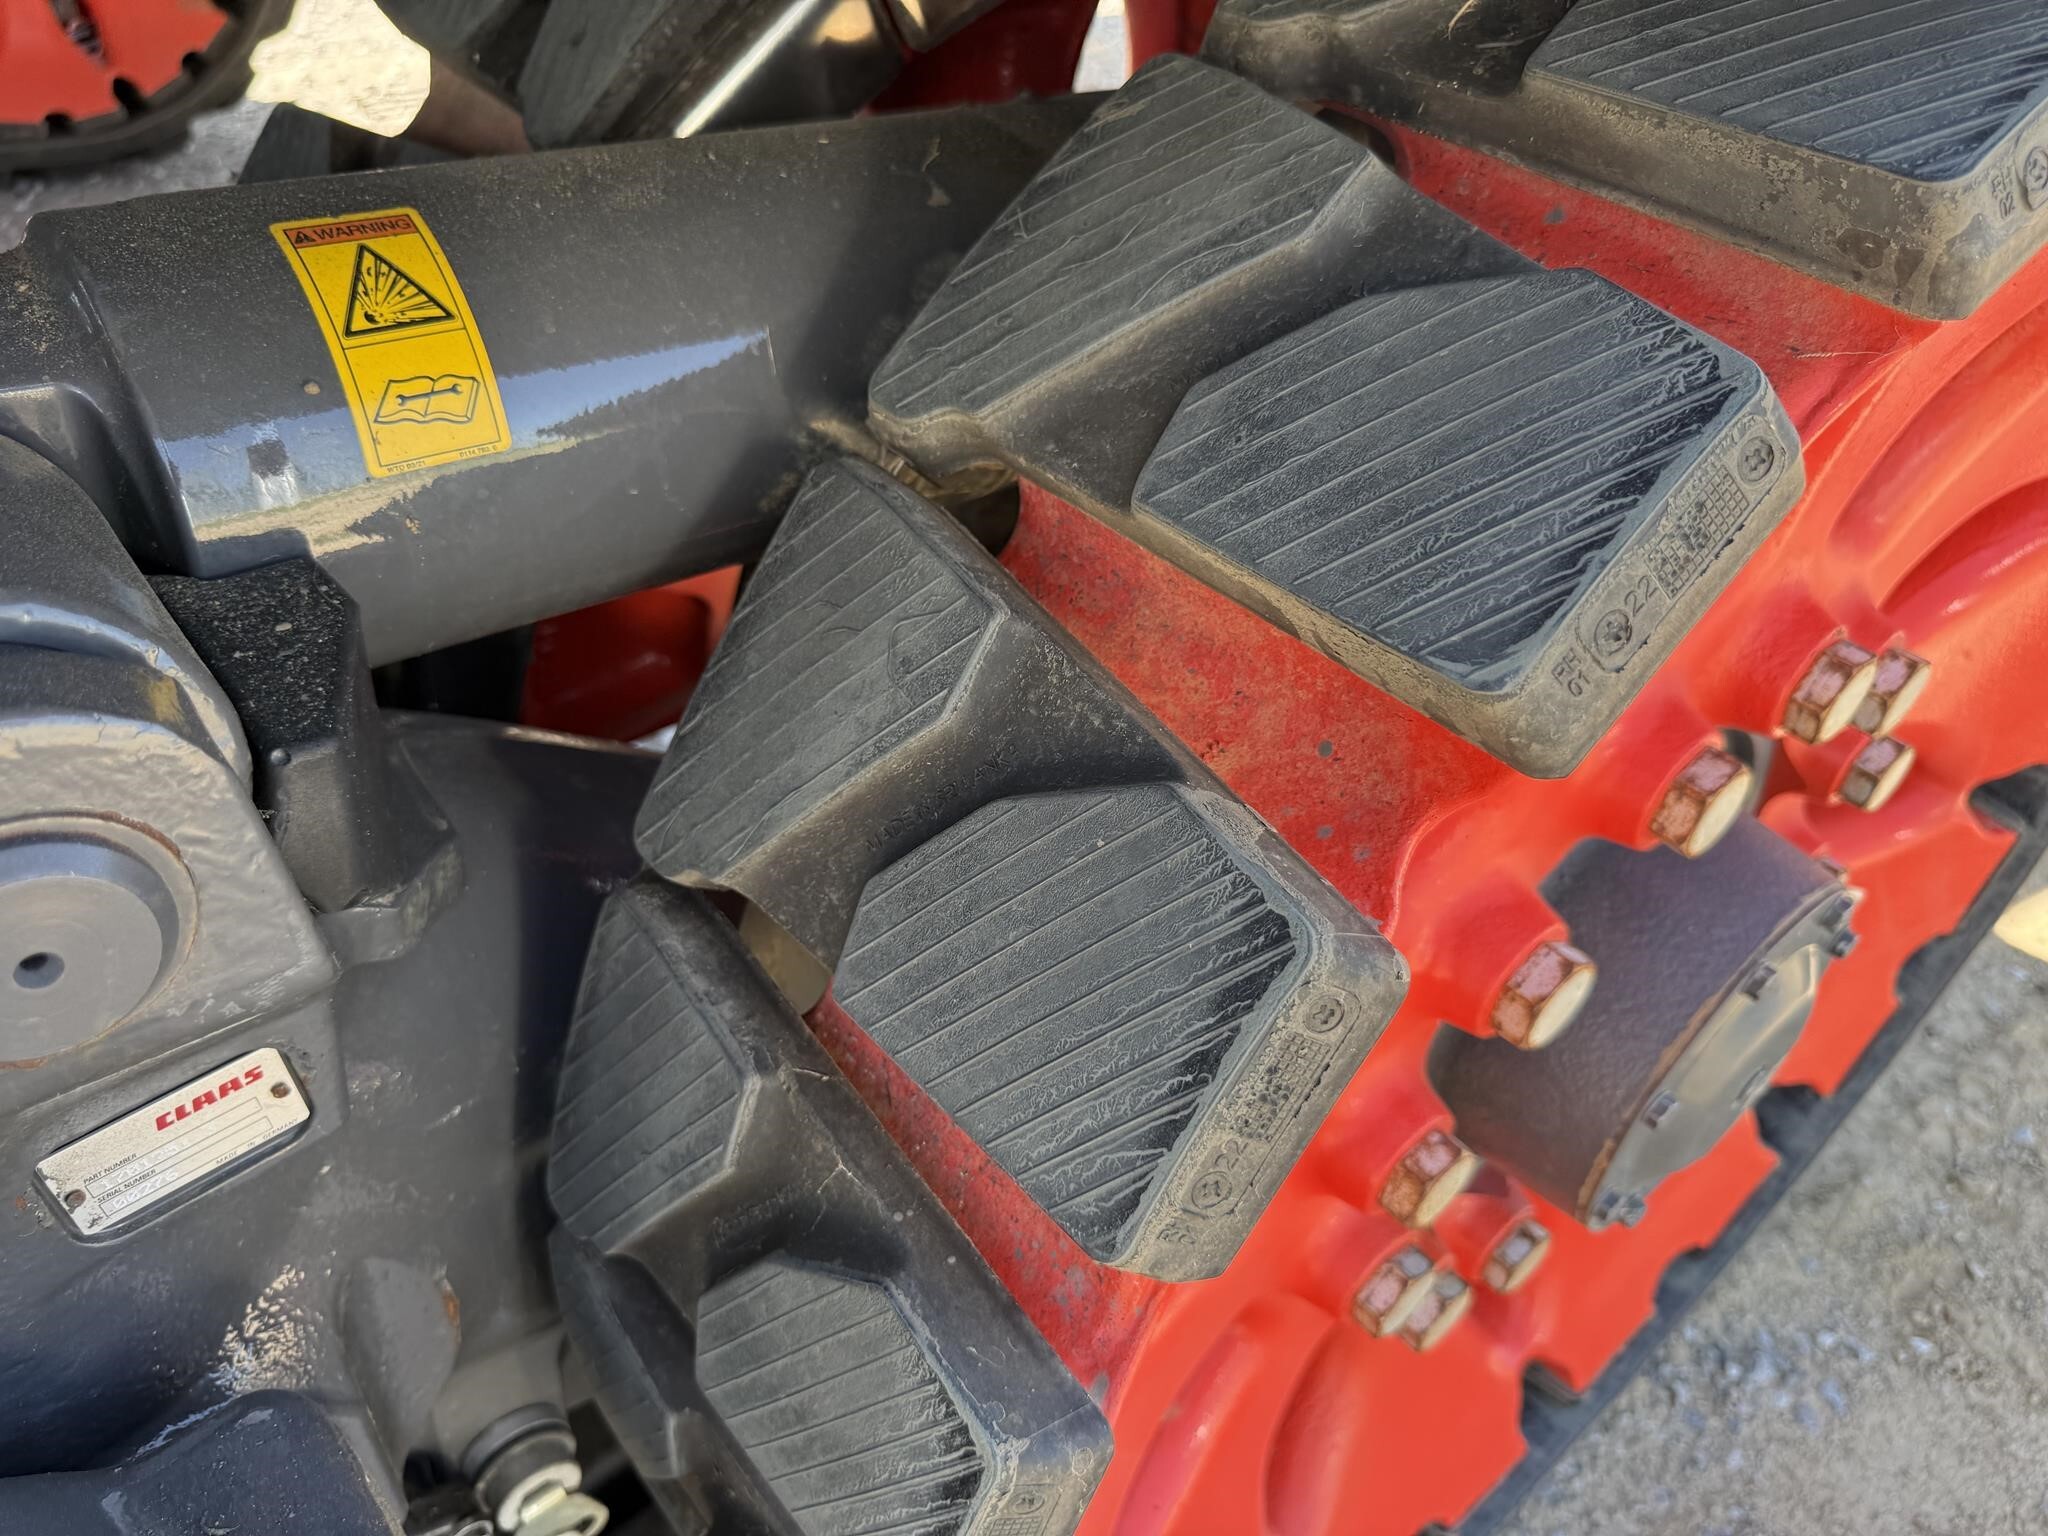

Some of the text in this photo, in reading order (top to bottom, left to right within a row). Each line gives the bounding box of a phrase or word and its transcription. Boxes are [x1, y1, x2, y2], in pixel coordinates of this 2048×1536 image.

[313, 218, 412, 240] WARNING
[1624, 575, 1660, 617] 22
[1566, 668, 1591, 697] 01
[155, 1065, 264, 1131] CLAAS
[261, 1117, 299, 1140] GERMANY
[83, 1153, 137, 1184] PART NUMBER
[1214, 1138, 1249, 1171] 22
[97, 1168, 157, 1203] SERIAL NUMBER
